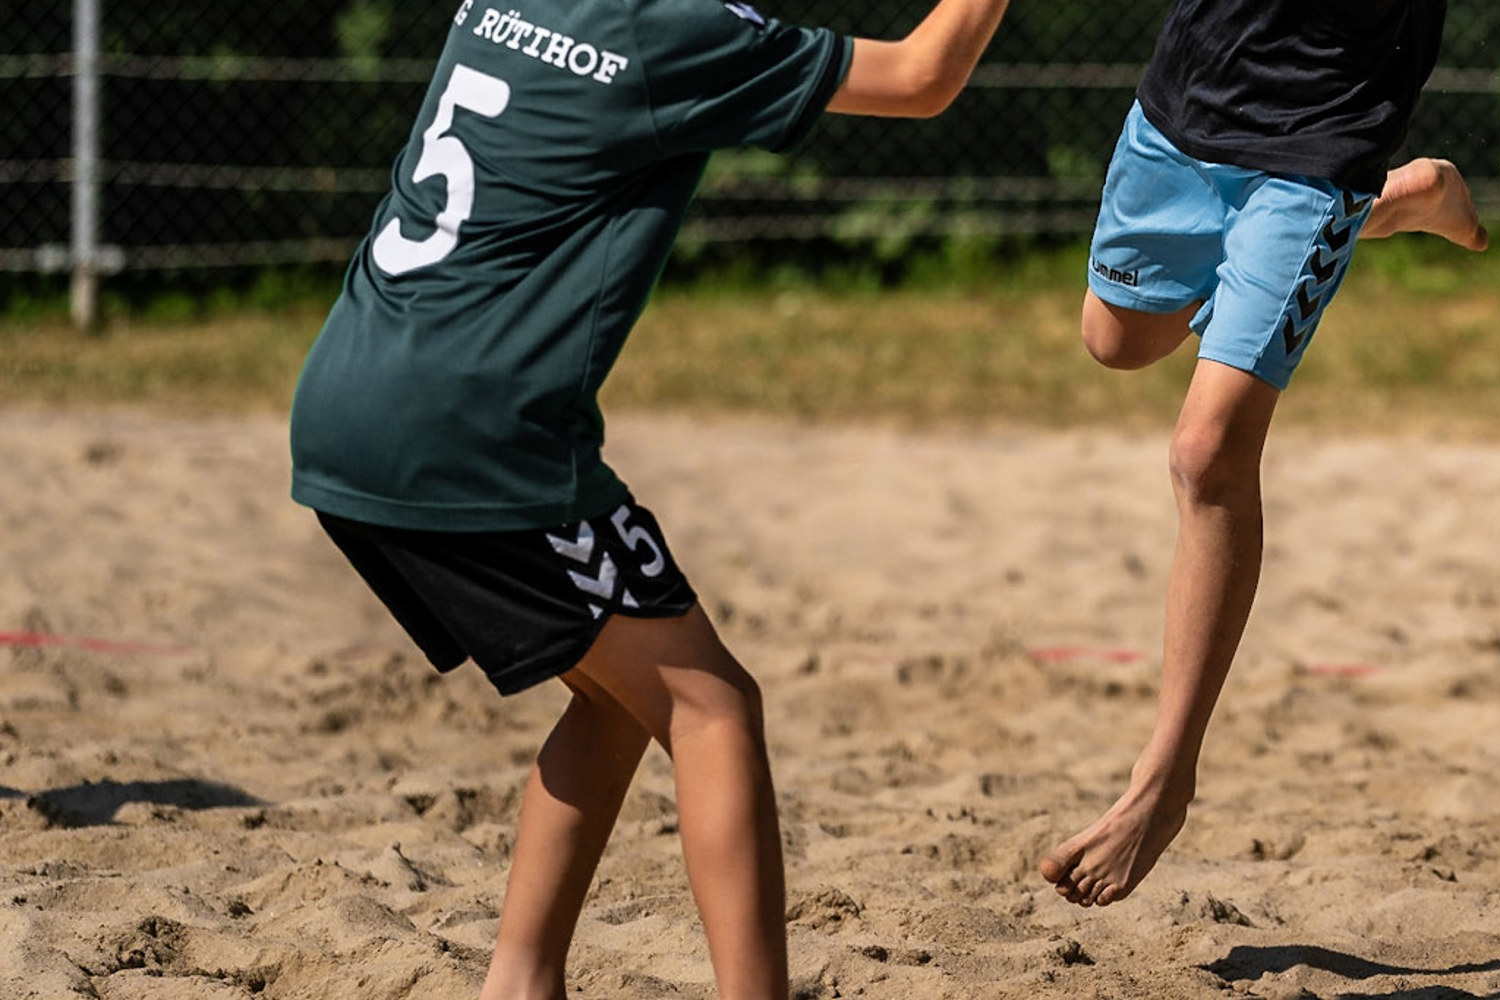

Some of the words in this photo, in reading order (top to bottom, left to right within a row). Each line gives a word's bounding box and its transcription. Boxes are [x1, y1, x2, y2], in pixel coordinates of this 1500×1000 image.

[473, 8, 628, 84] RÜTIHOF
[372, 63, 511, 276] 5
[610, 504, 665, 578] 5
